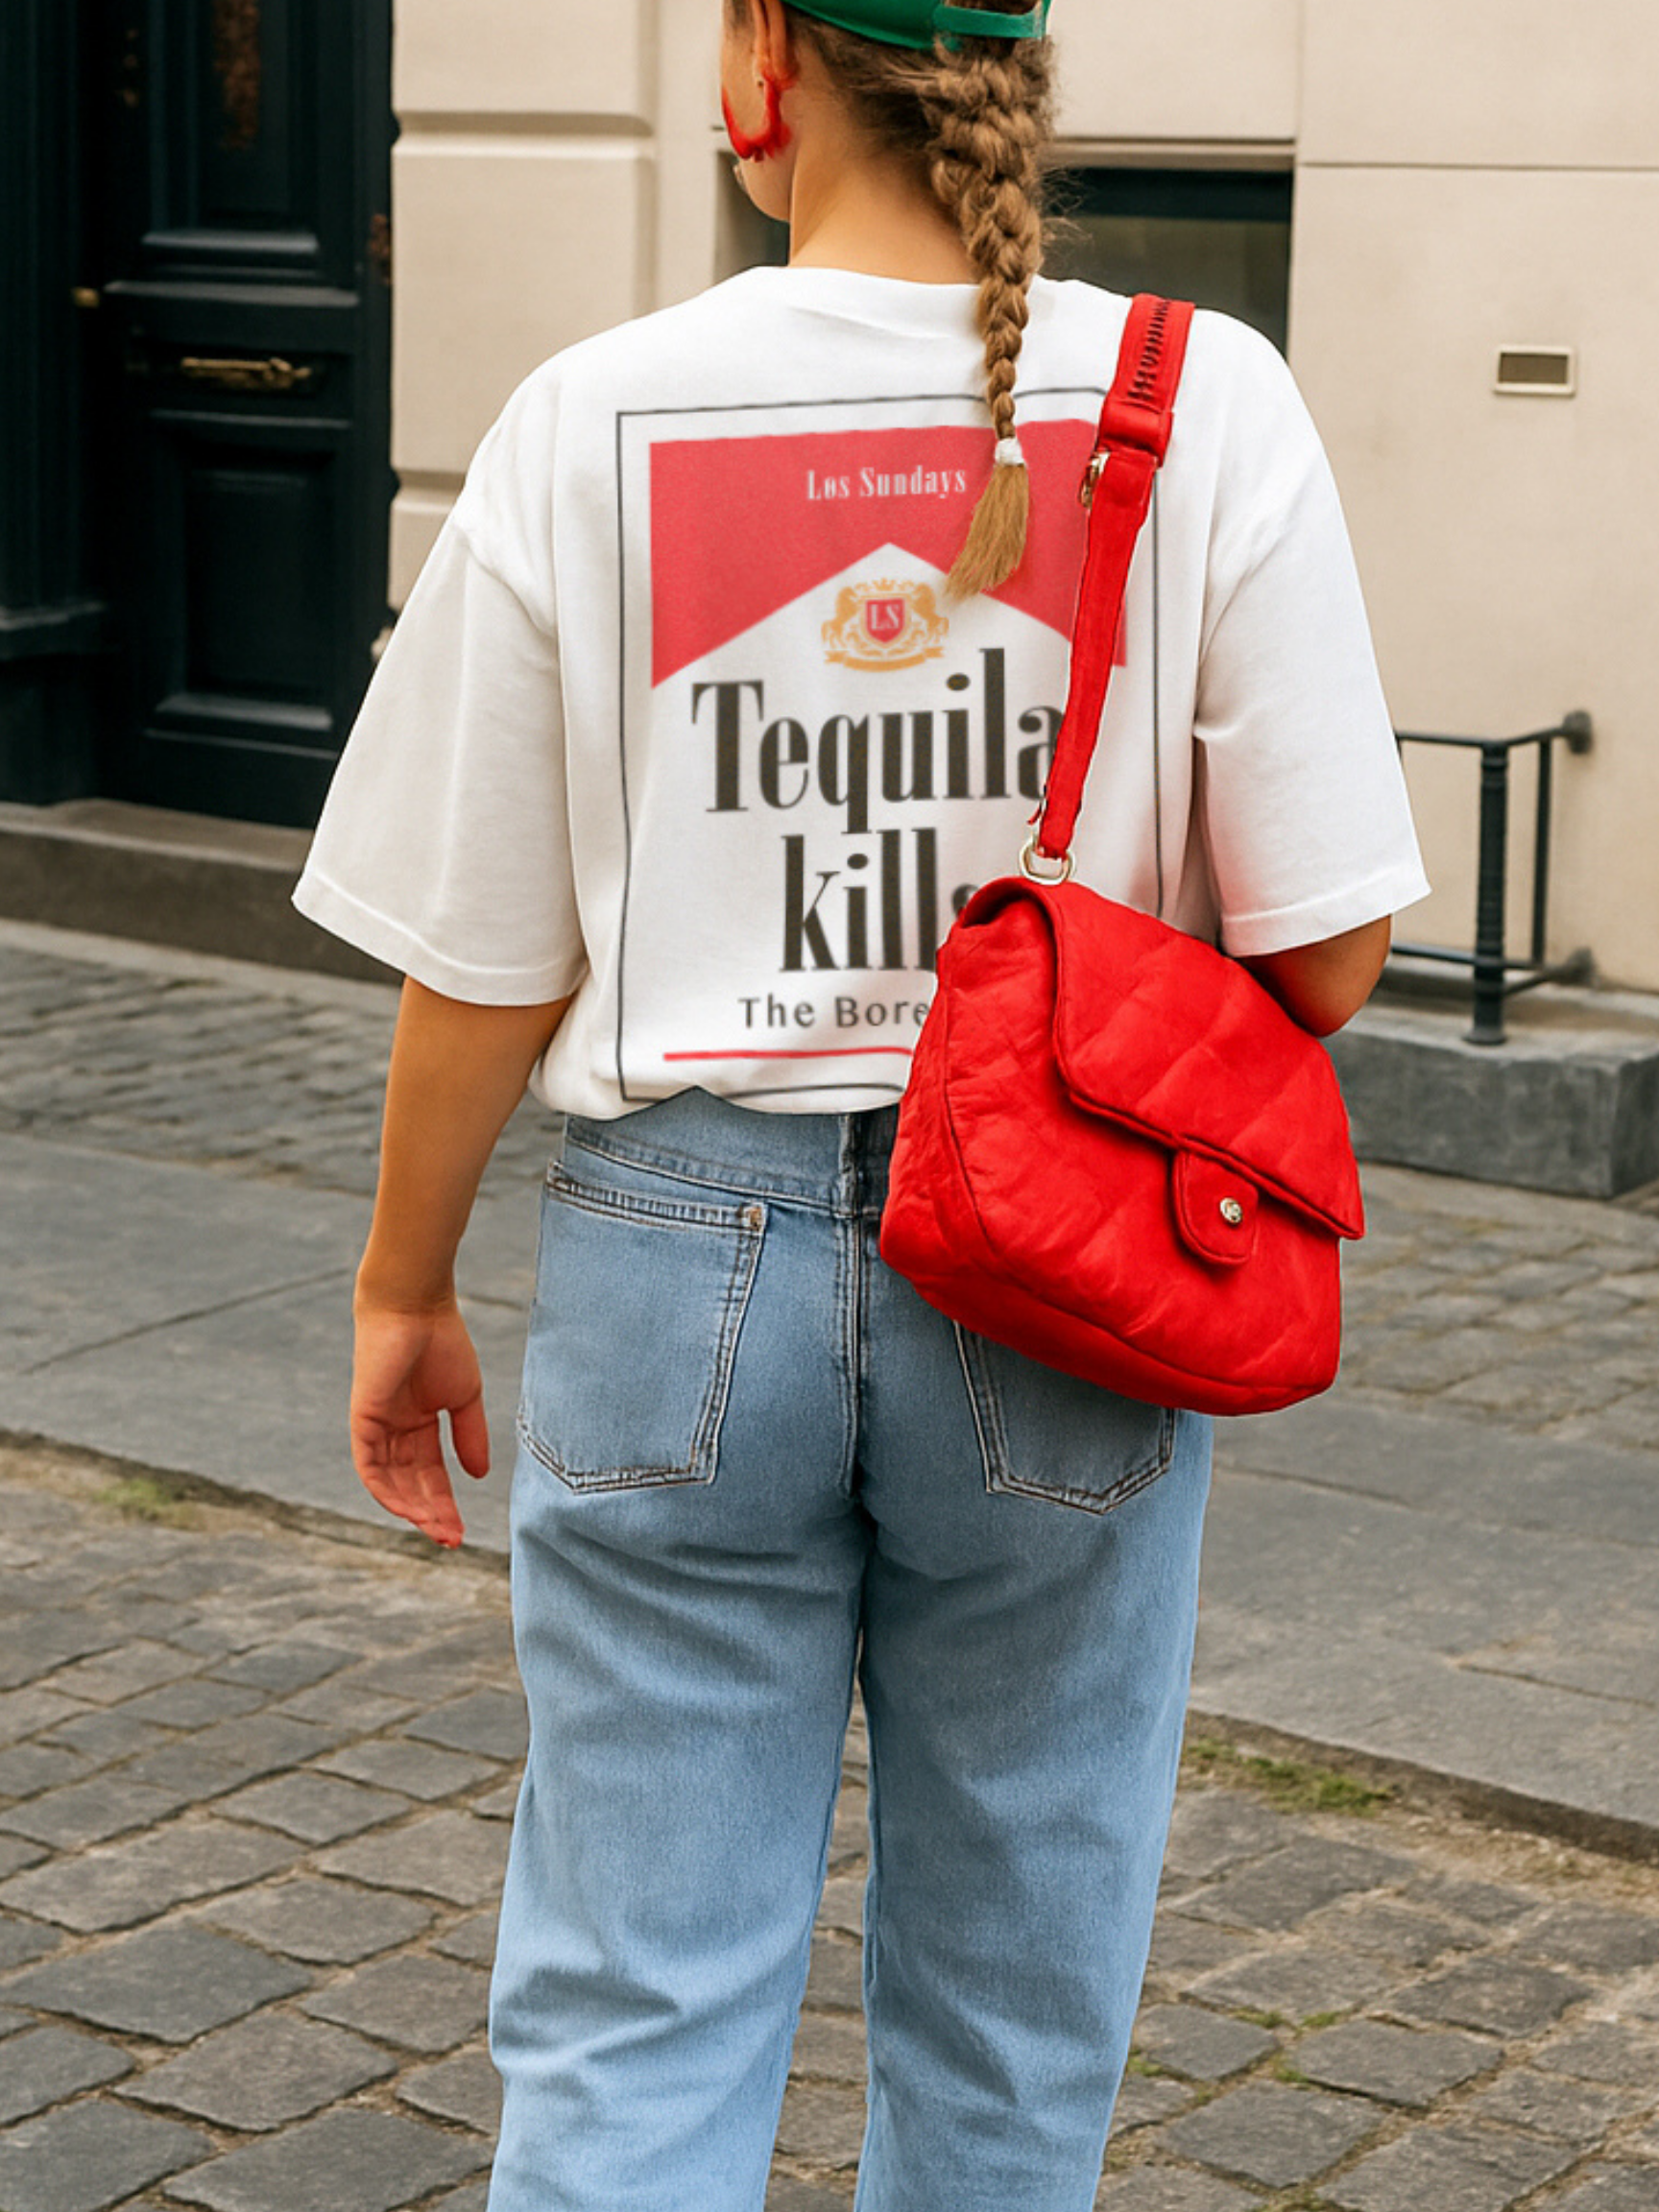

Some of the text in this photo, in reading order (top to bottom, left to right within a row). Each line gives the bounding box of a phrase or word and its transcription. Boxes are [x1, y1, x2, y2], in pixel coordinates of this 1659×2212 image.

[807, 465, 966, 500] Los Sundays
[871, 604, 900, 630] LS
[692, 647, 1064, 834] Tequila
[779, 827, 978, 973] kill
[738, 993, 815, 1028] The
